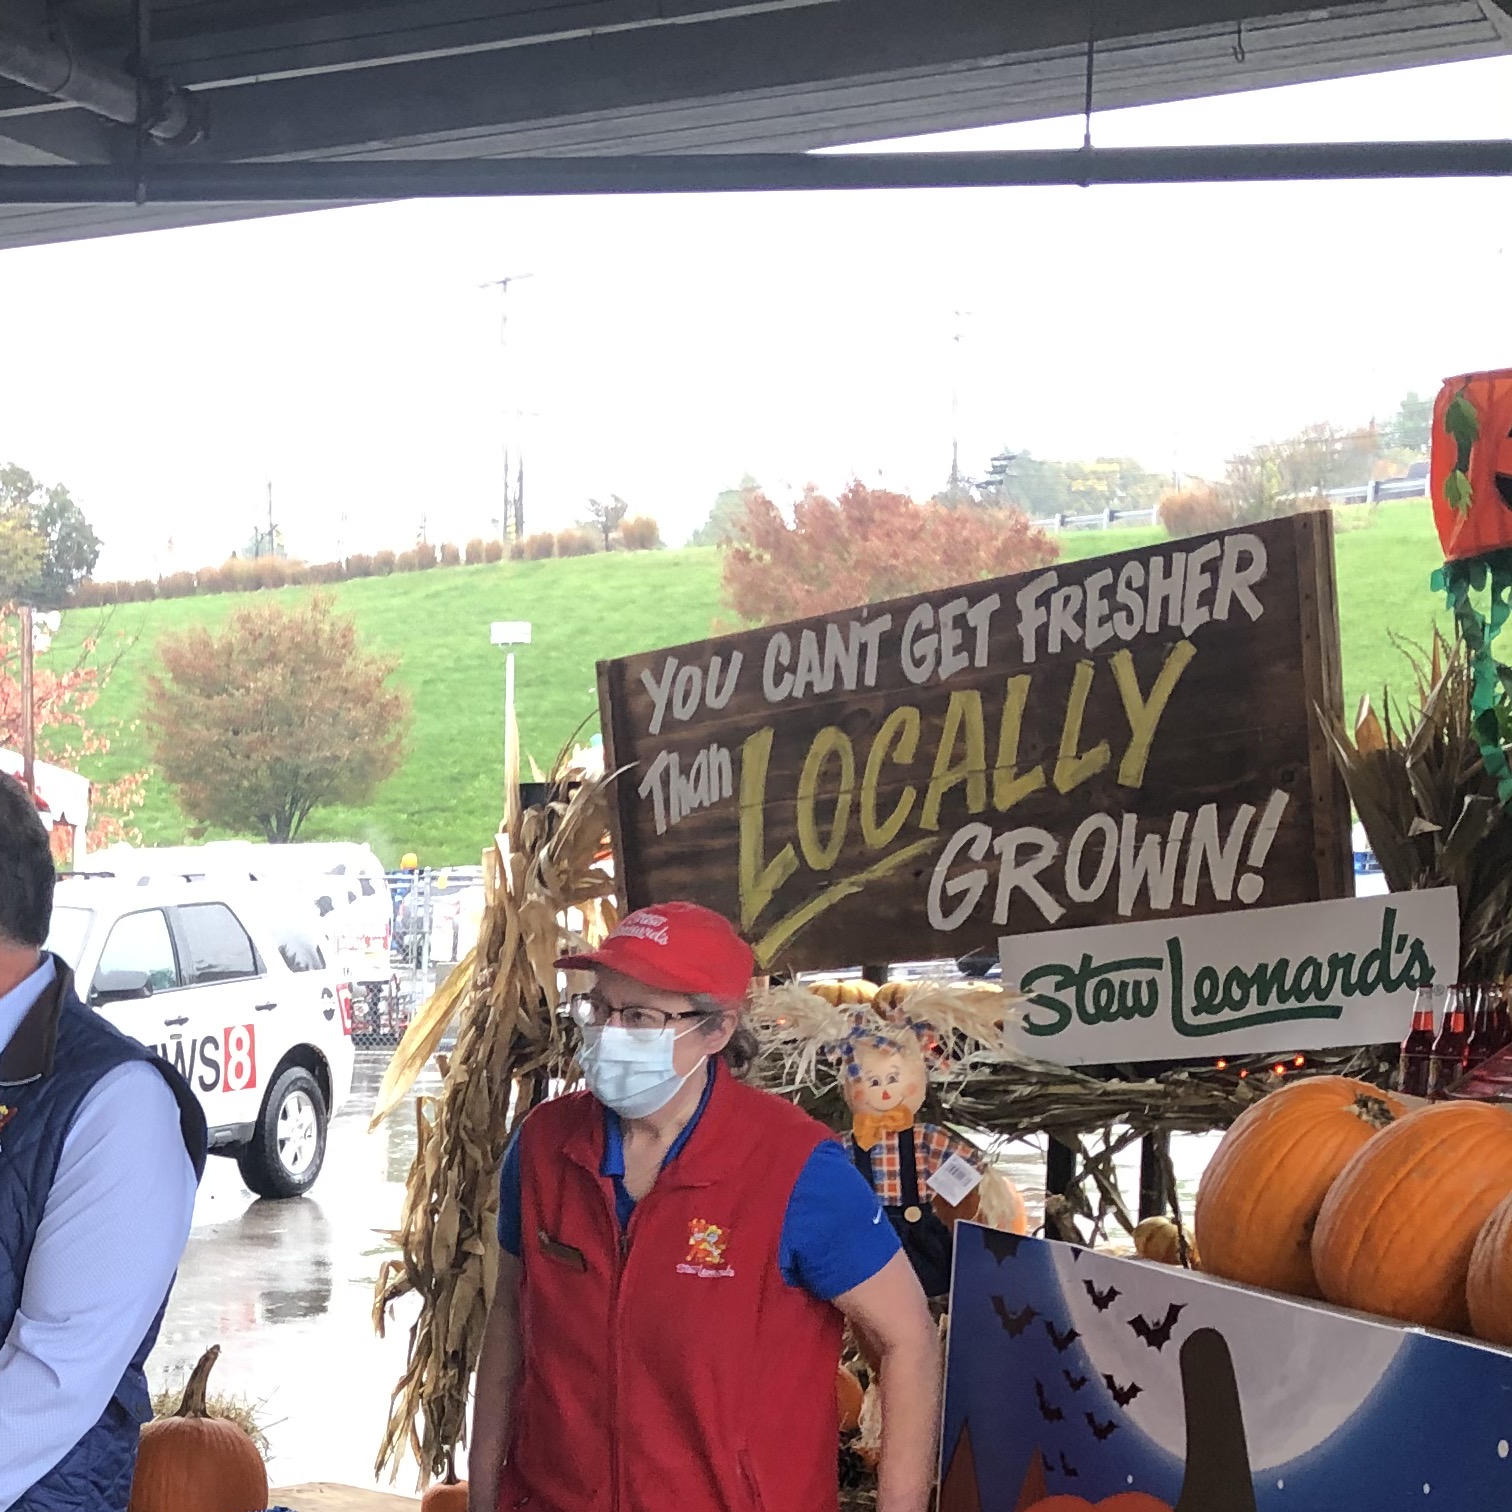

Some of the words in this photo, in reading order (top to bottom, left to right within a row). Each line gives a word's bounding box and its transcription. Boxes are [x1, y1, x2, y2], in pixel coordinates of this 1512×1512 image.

[639, 651, 743, 735] YOU
[763, 606, 892, 703] CAN'T
[900, 596, 1000, 684] GET
[1016, 533, 1268, 663] FRESHER
[639, 743, 732, 835] Than
[738, 640, 1197, 932] LOCALLY
[926, 789, 1289, 931] GROWN!
[1020, 952, 1164, 1037] Stew
[1167, 905, 1435, 1038] Leonard's
